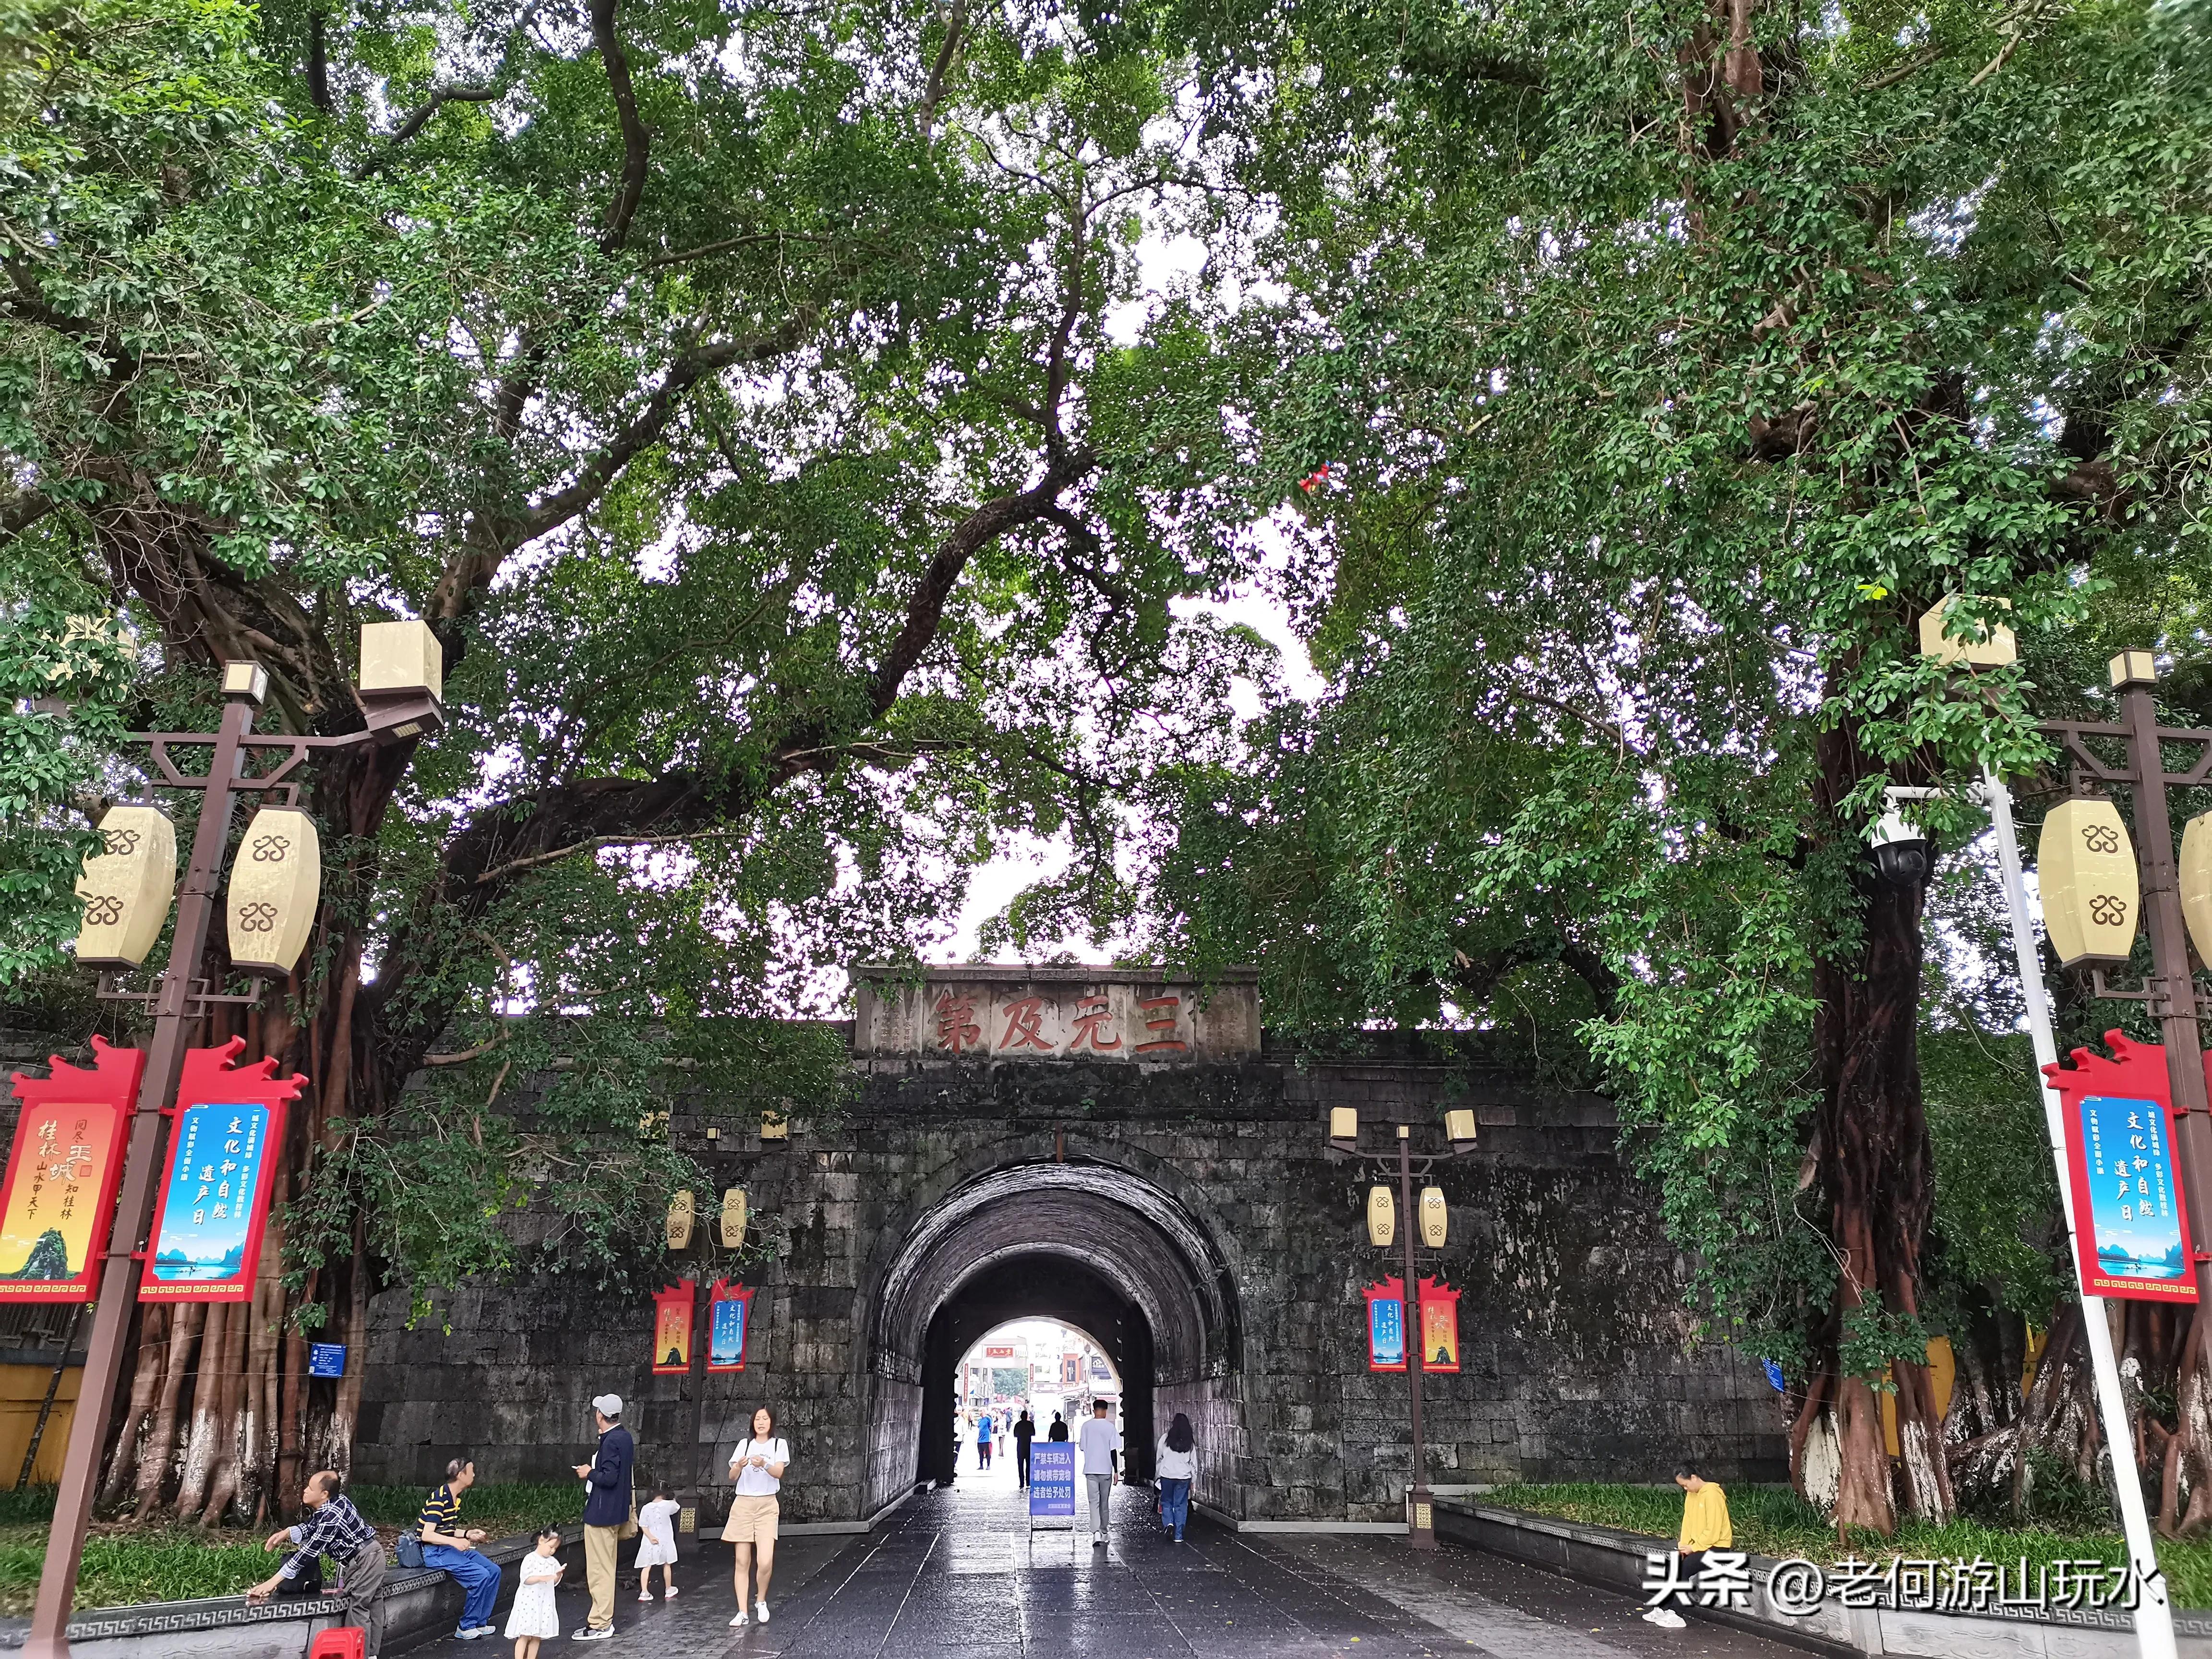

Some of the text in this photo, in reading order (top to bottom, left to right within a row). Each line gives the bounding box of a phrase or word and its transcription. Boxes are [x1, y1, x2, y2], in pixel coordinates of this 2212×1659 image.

[212, 1116, 243, 1219] 文化和自然
[2114, 1159, 2133, 1221] 遗产日
[2127, 1111, 2155, 1216] 文化和自然
[192, 1164, 215, 1225] 遗产日
[1034, 1453, 1071, 1465] 严禁车辆进入
[1034, 1469, 1071, 1481] 请勿携带宠物
